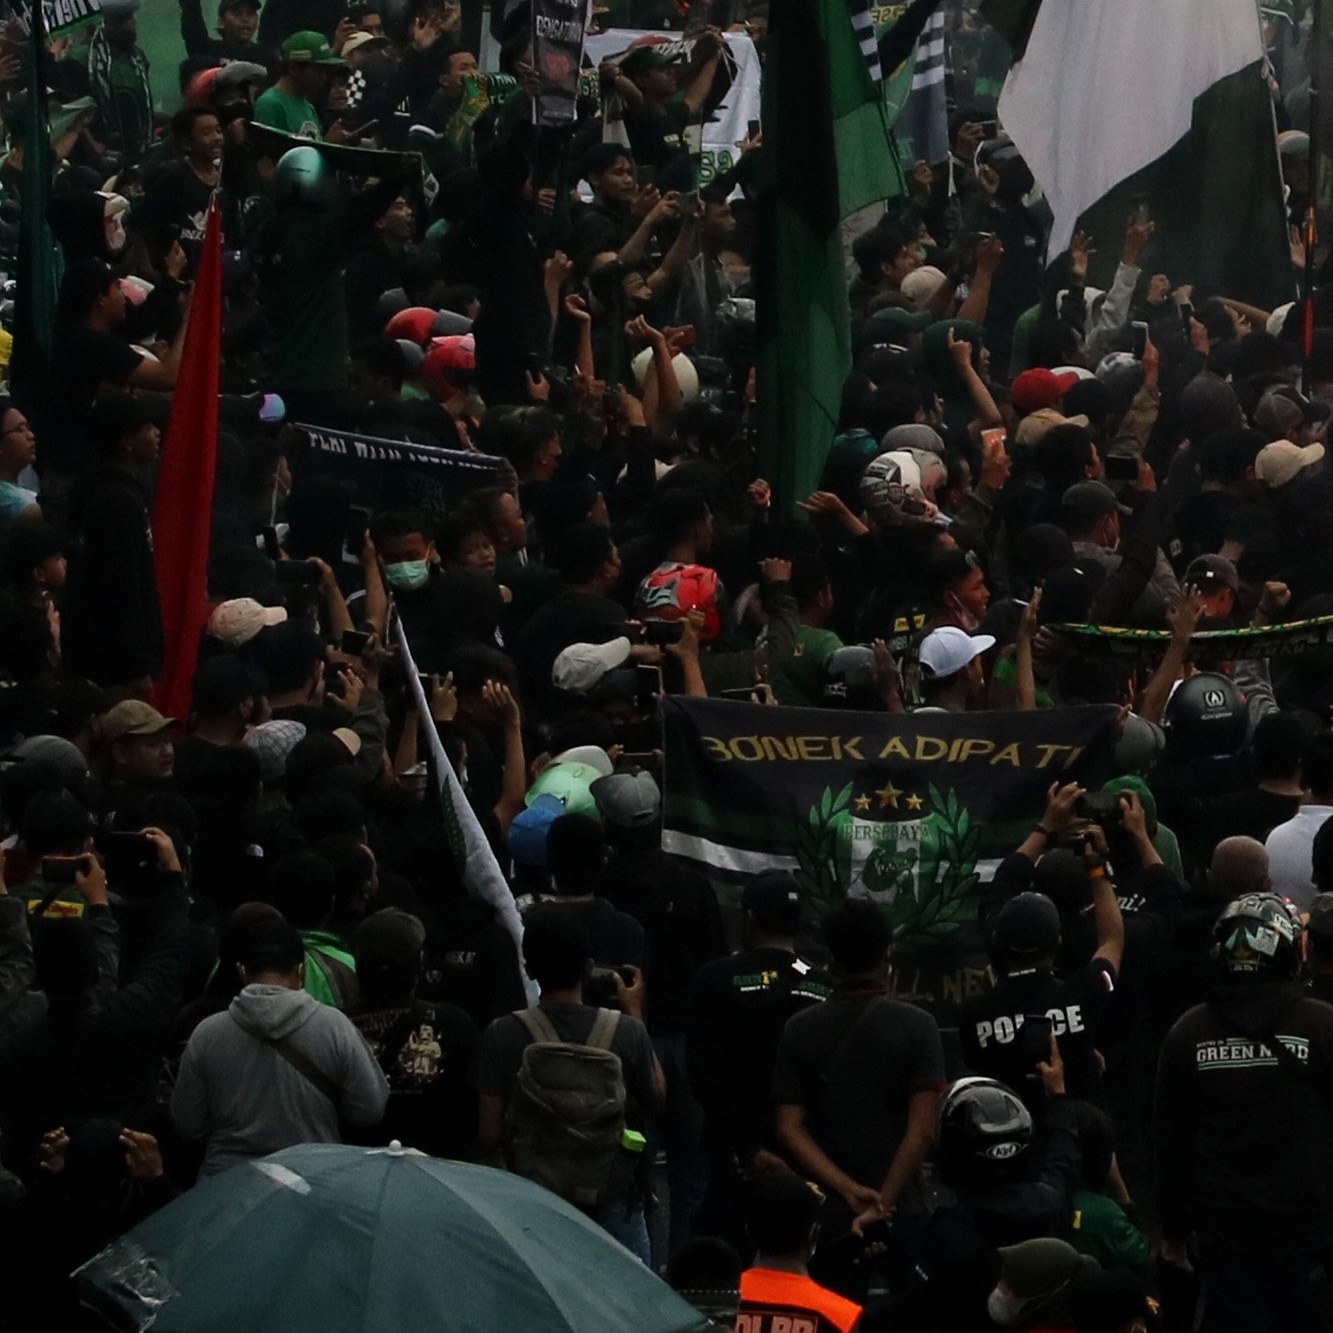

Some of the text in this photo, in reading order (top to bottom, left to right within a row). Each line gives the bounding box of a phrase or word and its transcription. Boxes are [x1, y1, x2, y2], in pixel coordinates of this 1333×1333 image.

[699, 733, 864, 763] BONEK
[976, 1004, 1085, 1048] POCE
[1196, 1046, 1255, 1063] GREEN
